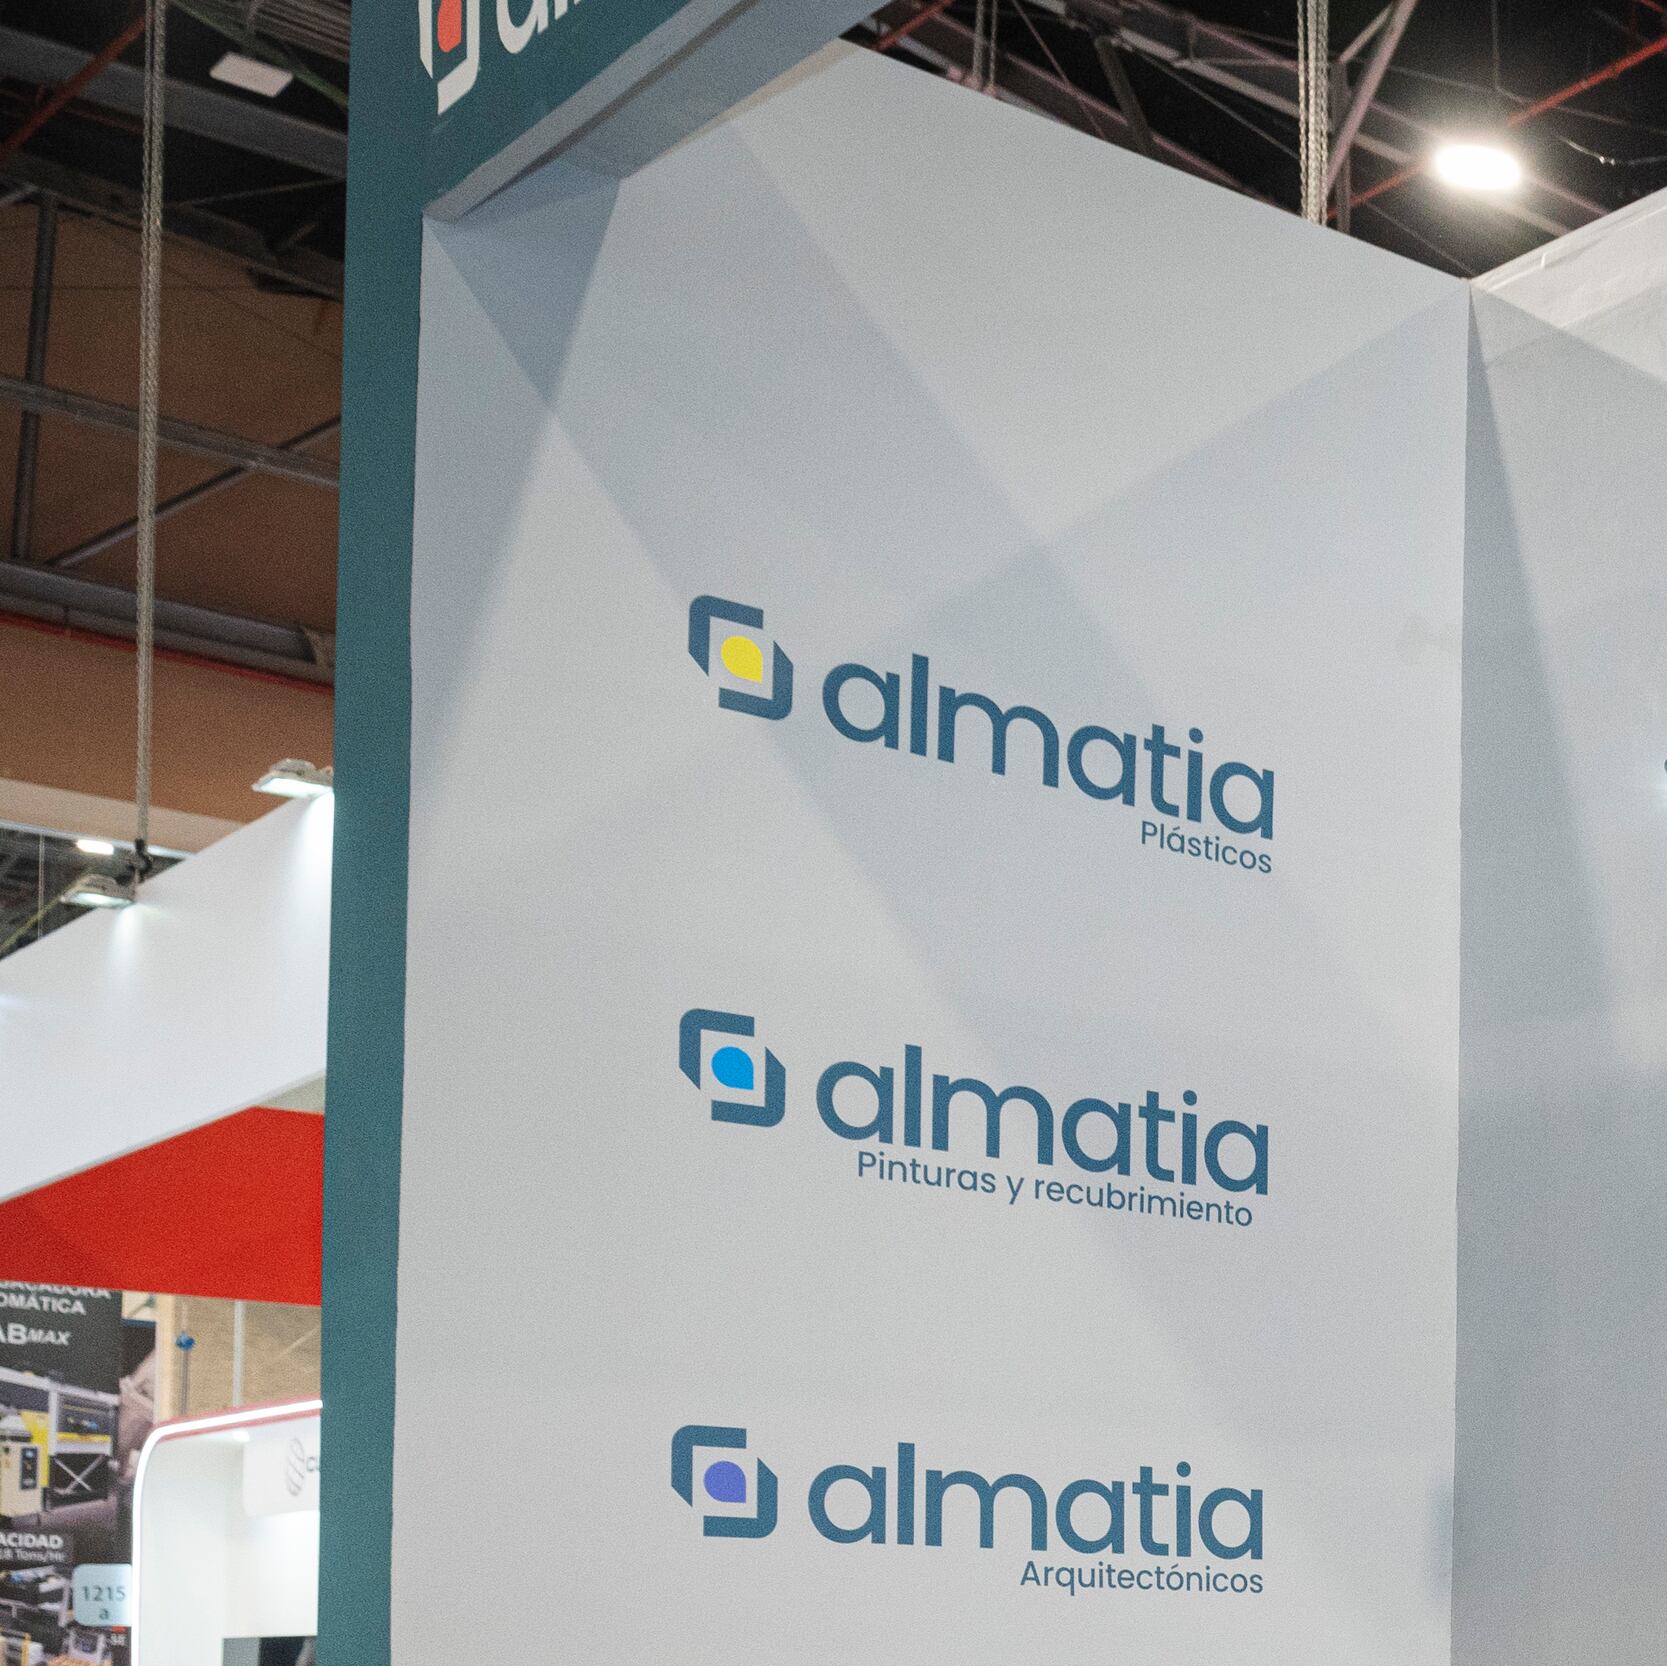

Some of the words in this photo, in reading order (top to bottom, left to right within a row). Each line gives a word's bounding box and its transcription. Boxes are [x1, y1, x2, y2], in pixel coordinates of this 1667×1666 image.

[821, 652, 1276, 841] almatia
[1140, 819, 1274, 875] Plásticos
[815, 1043, 1270, 1197] almatia
[857, 1150, 997, 1194] Pinturas
[1005, 1174, 1025, 1206] y
[1033, 1179, 1255, 1228] recubrimiento
[806, 1441, 1264, 1561] almatia
[81, 1585, 126, 1602] 1215
[1020, 1560, 1264, 1597] Arquitectónicos
